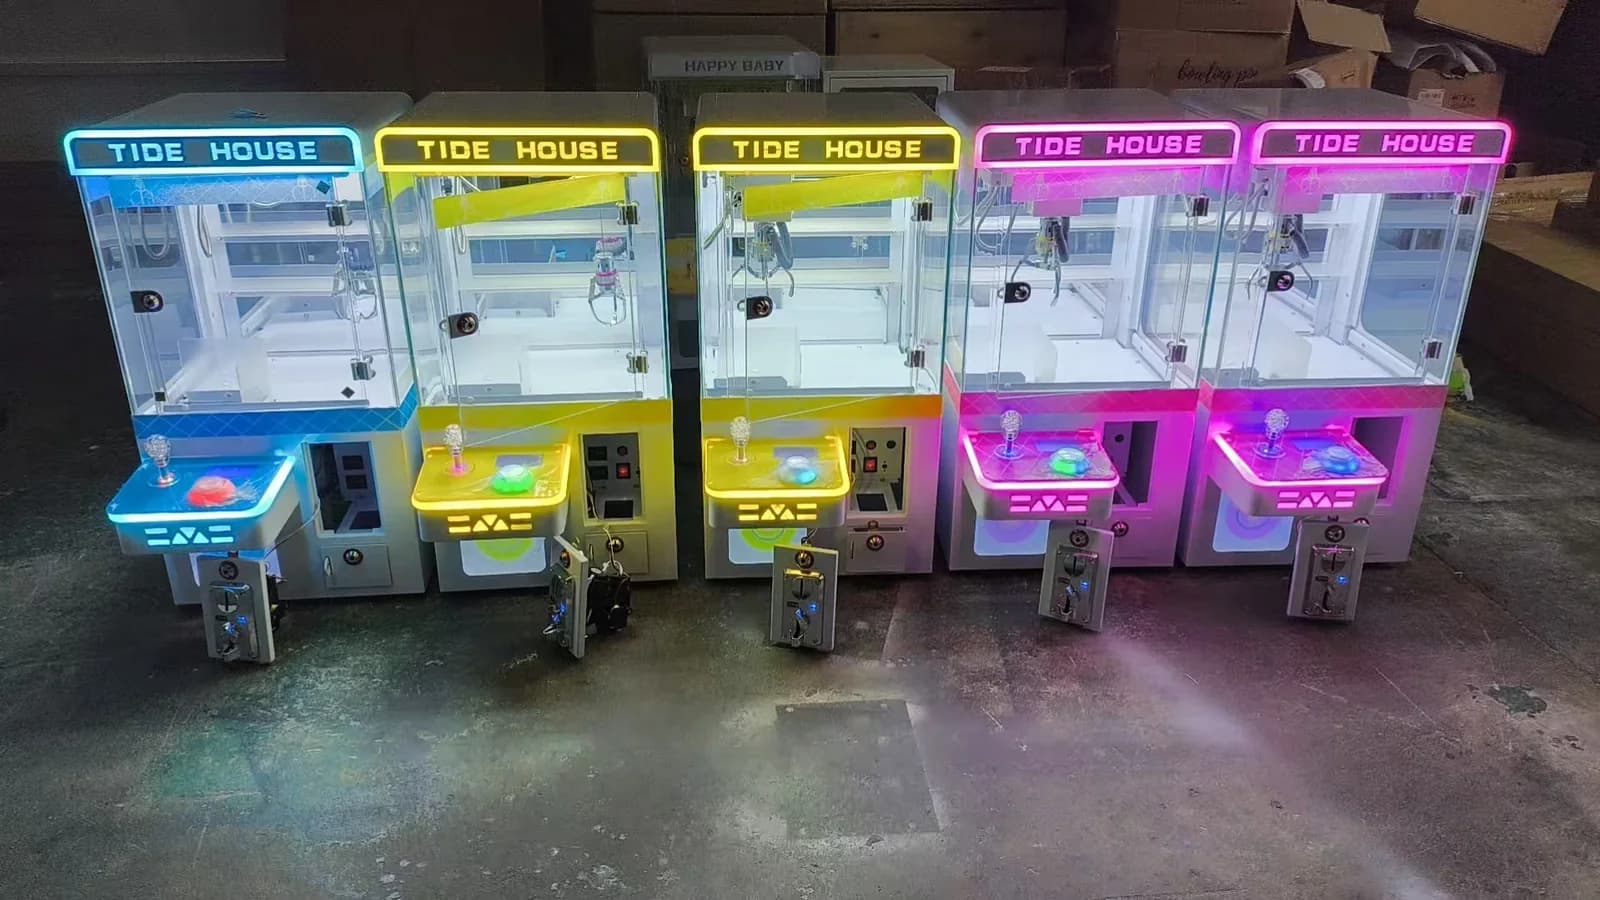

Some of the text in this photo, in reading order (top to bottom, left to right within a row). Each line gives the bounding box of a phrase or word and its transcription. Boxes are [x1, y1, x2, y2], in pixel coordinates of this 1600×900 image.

[685, 59, 785, 73] HAPPY BABY
[108, 141, 318, 163] TIDE HOUSE
[417, 140, 618, 160] TIDE HOUSE
[733, 139, 922, 159] TIDE HOUSE
[1015, 135, 1204, 156] TIDE HOUSE
[1296, 134, 1476, 153] TIDE HOUSE
